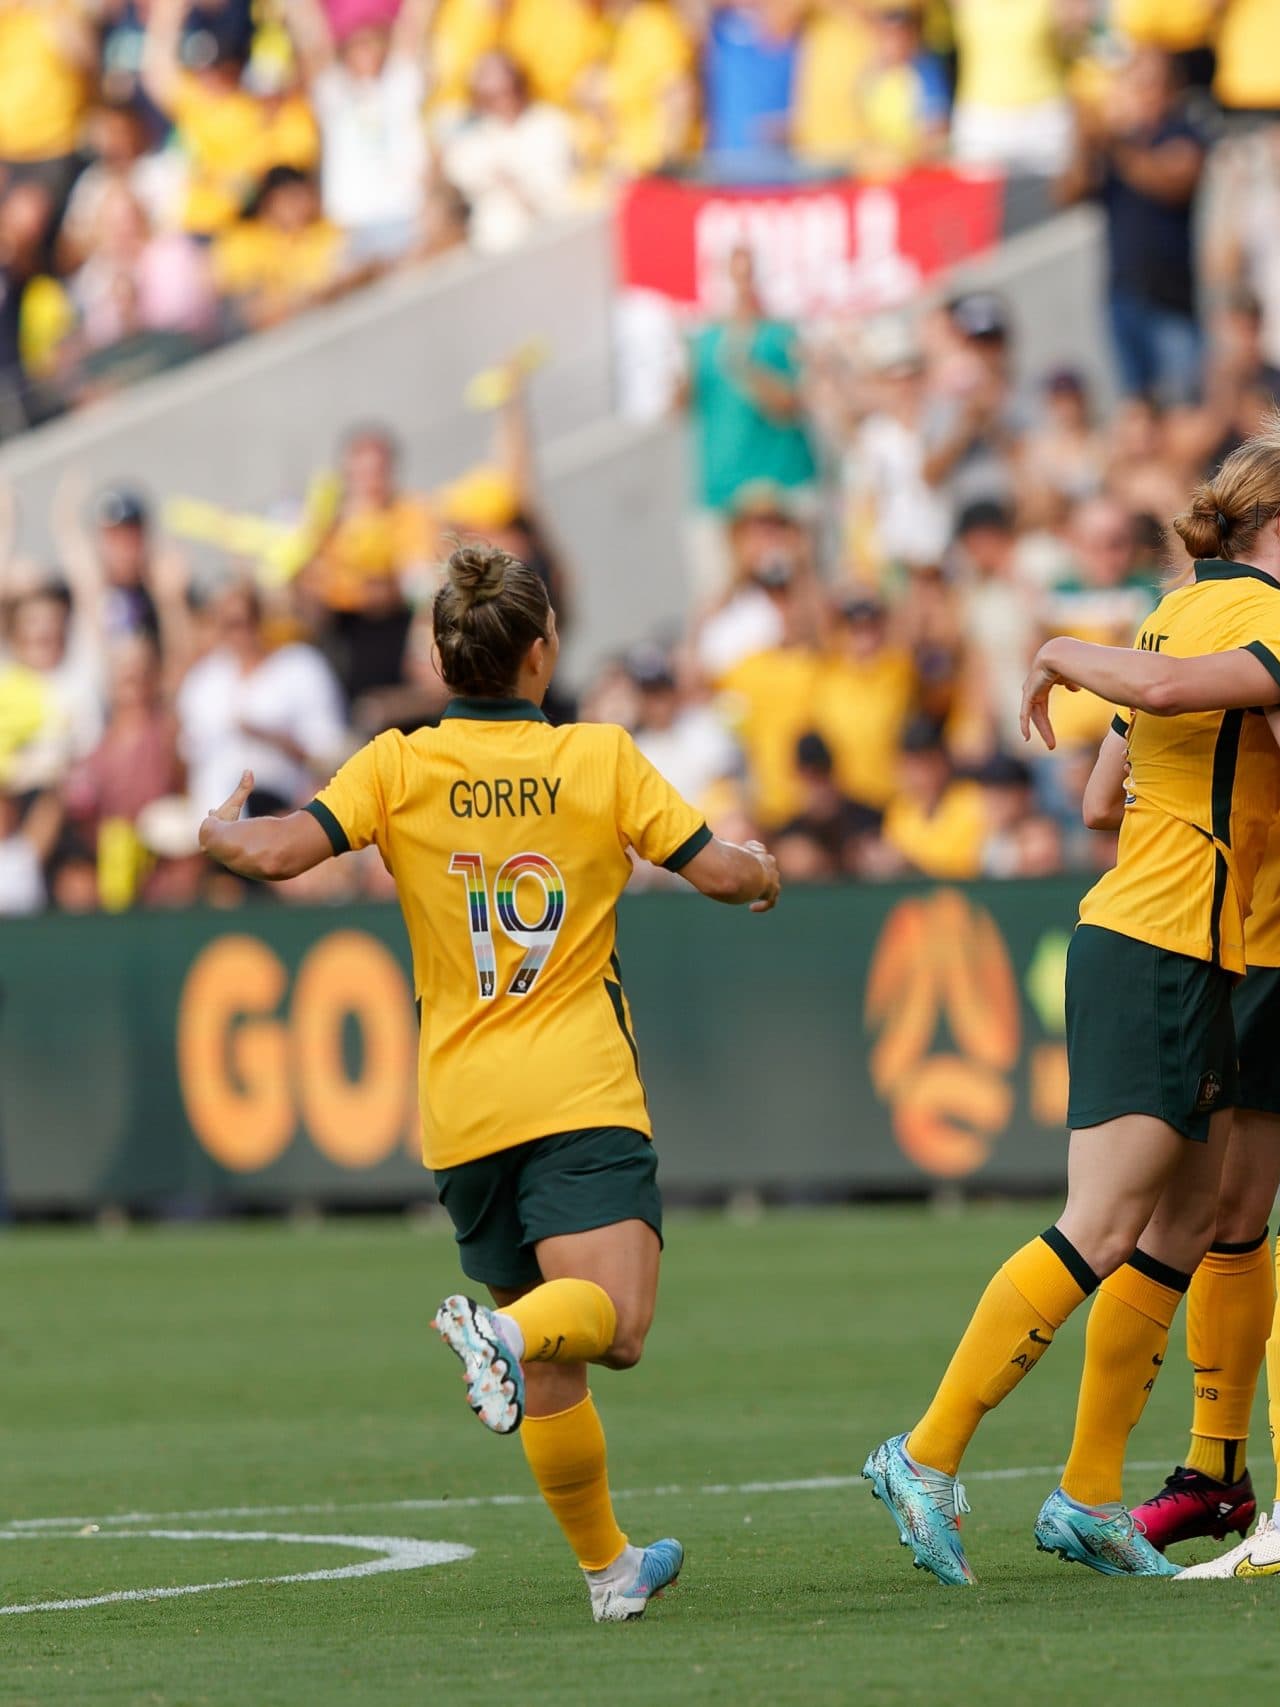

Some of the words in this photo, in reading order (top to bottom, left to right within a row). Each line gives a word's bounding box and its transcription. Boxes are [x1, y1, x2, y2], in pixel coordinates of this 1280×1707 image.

[449, 777, 562, 818] GORRY
[448, 851, 566, 1001] 19
[177, 928, 421, 1174] GO
[1011, 1353, 1039, 1372] AU
[1194, 1386, 1219, 1401] US
